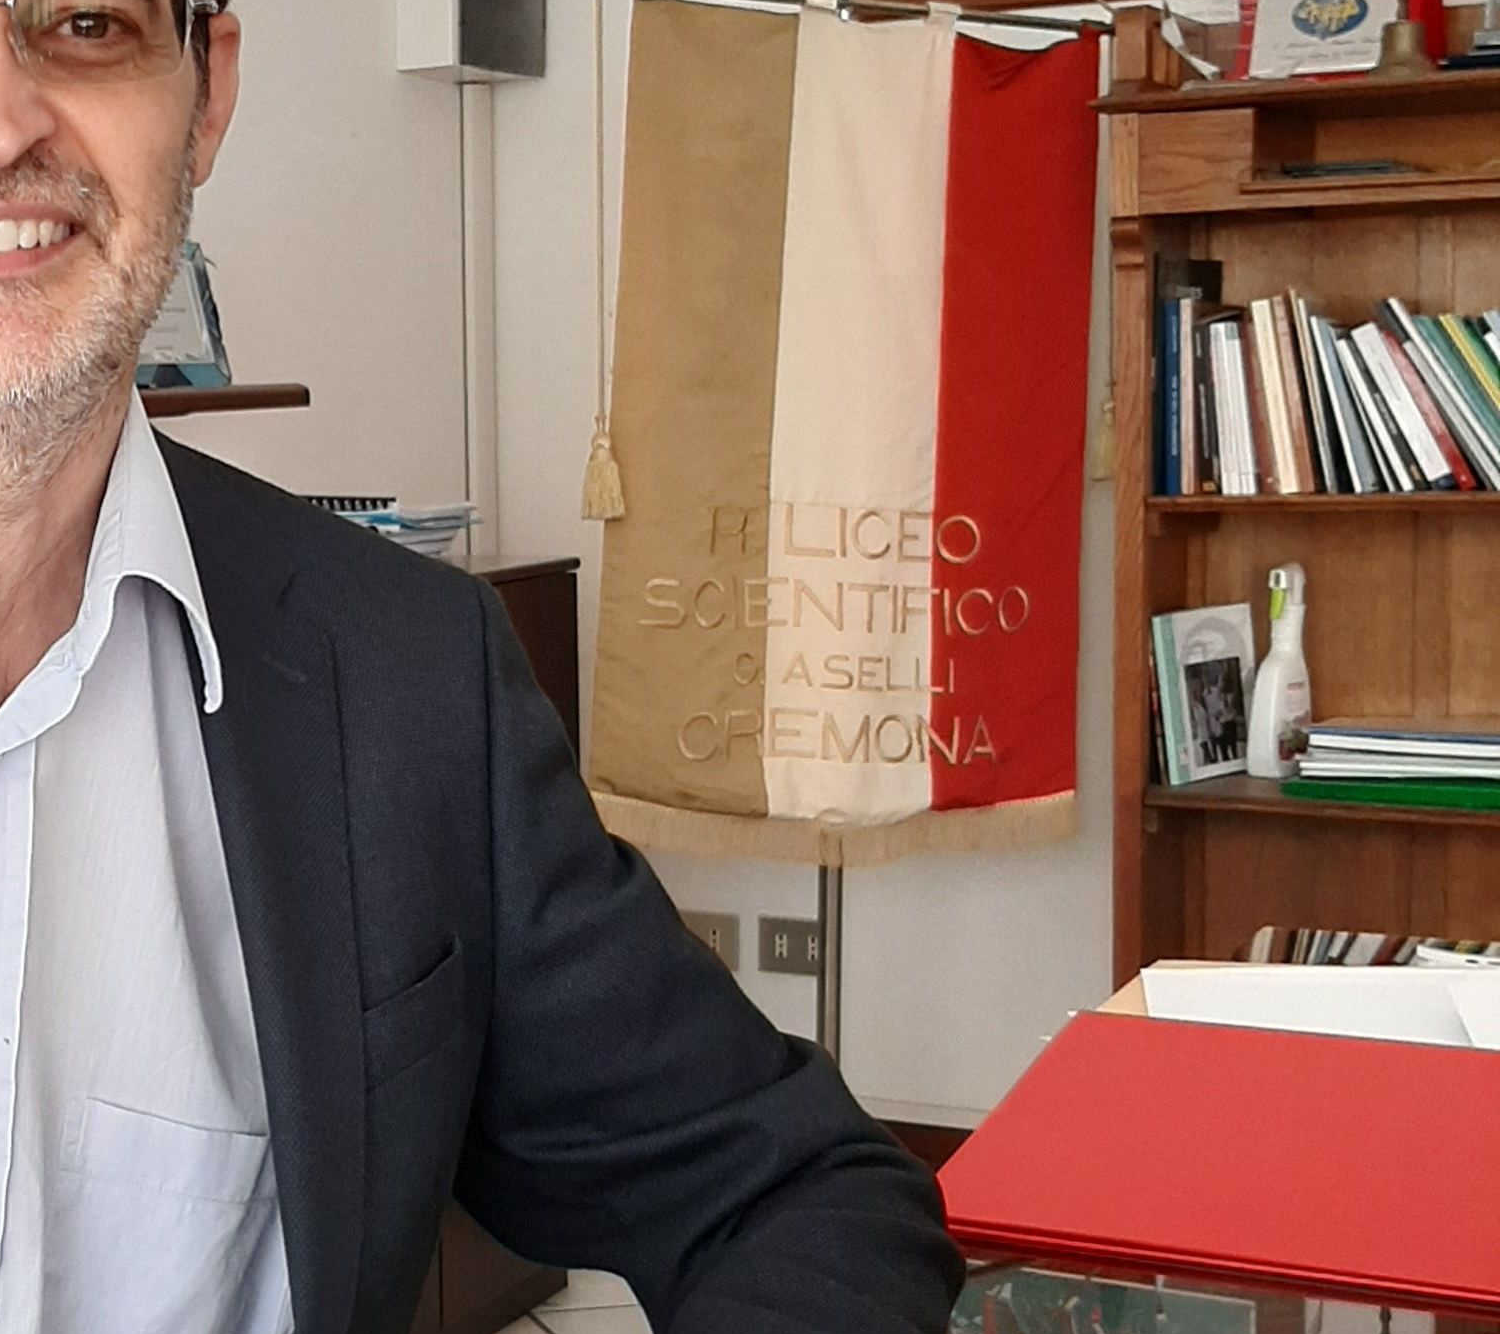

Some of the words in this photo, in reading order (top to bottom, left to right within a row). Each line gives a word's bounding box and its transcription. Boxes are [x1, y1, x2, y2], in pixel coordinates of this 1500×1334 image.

[783, 502, 981, 564] LICEO
[638, 576, 1031, 636] SCIENTIFICO
[781, 652, 955, 695] ASELLI
[676, 707, 998, 765] CREMONA
